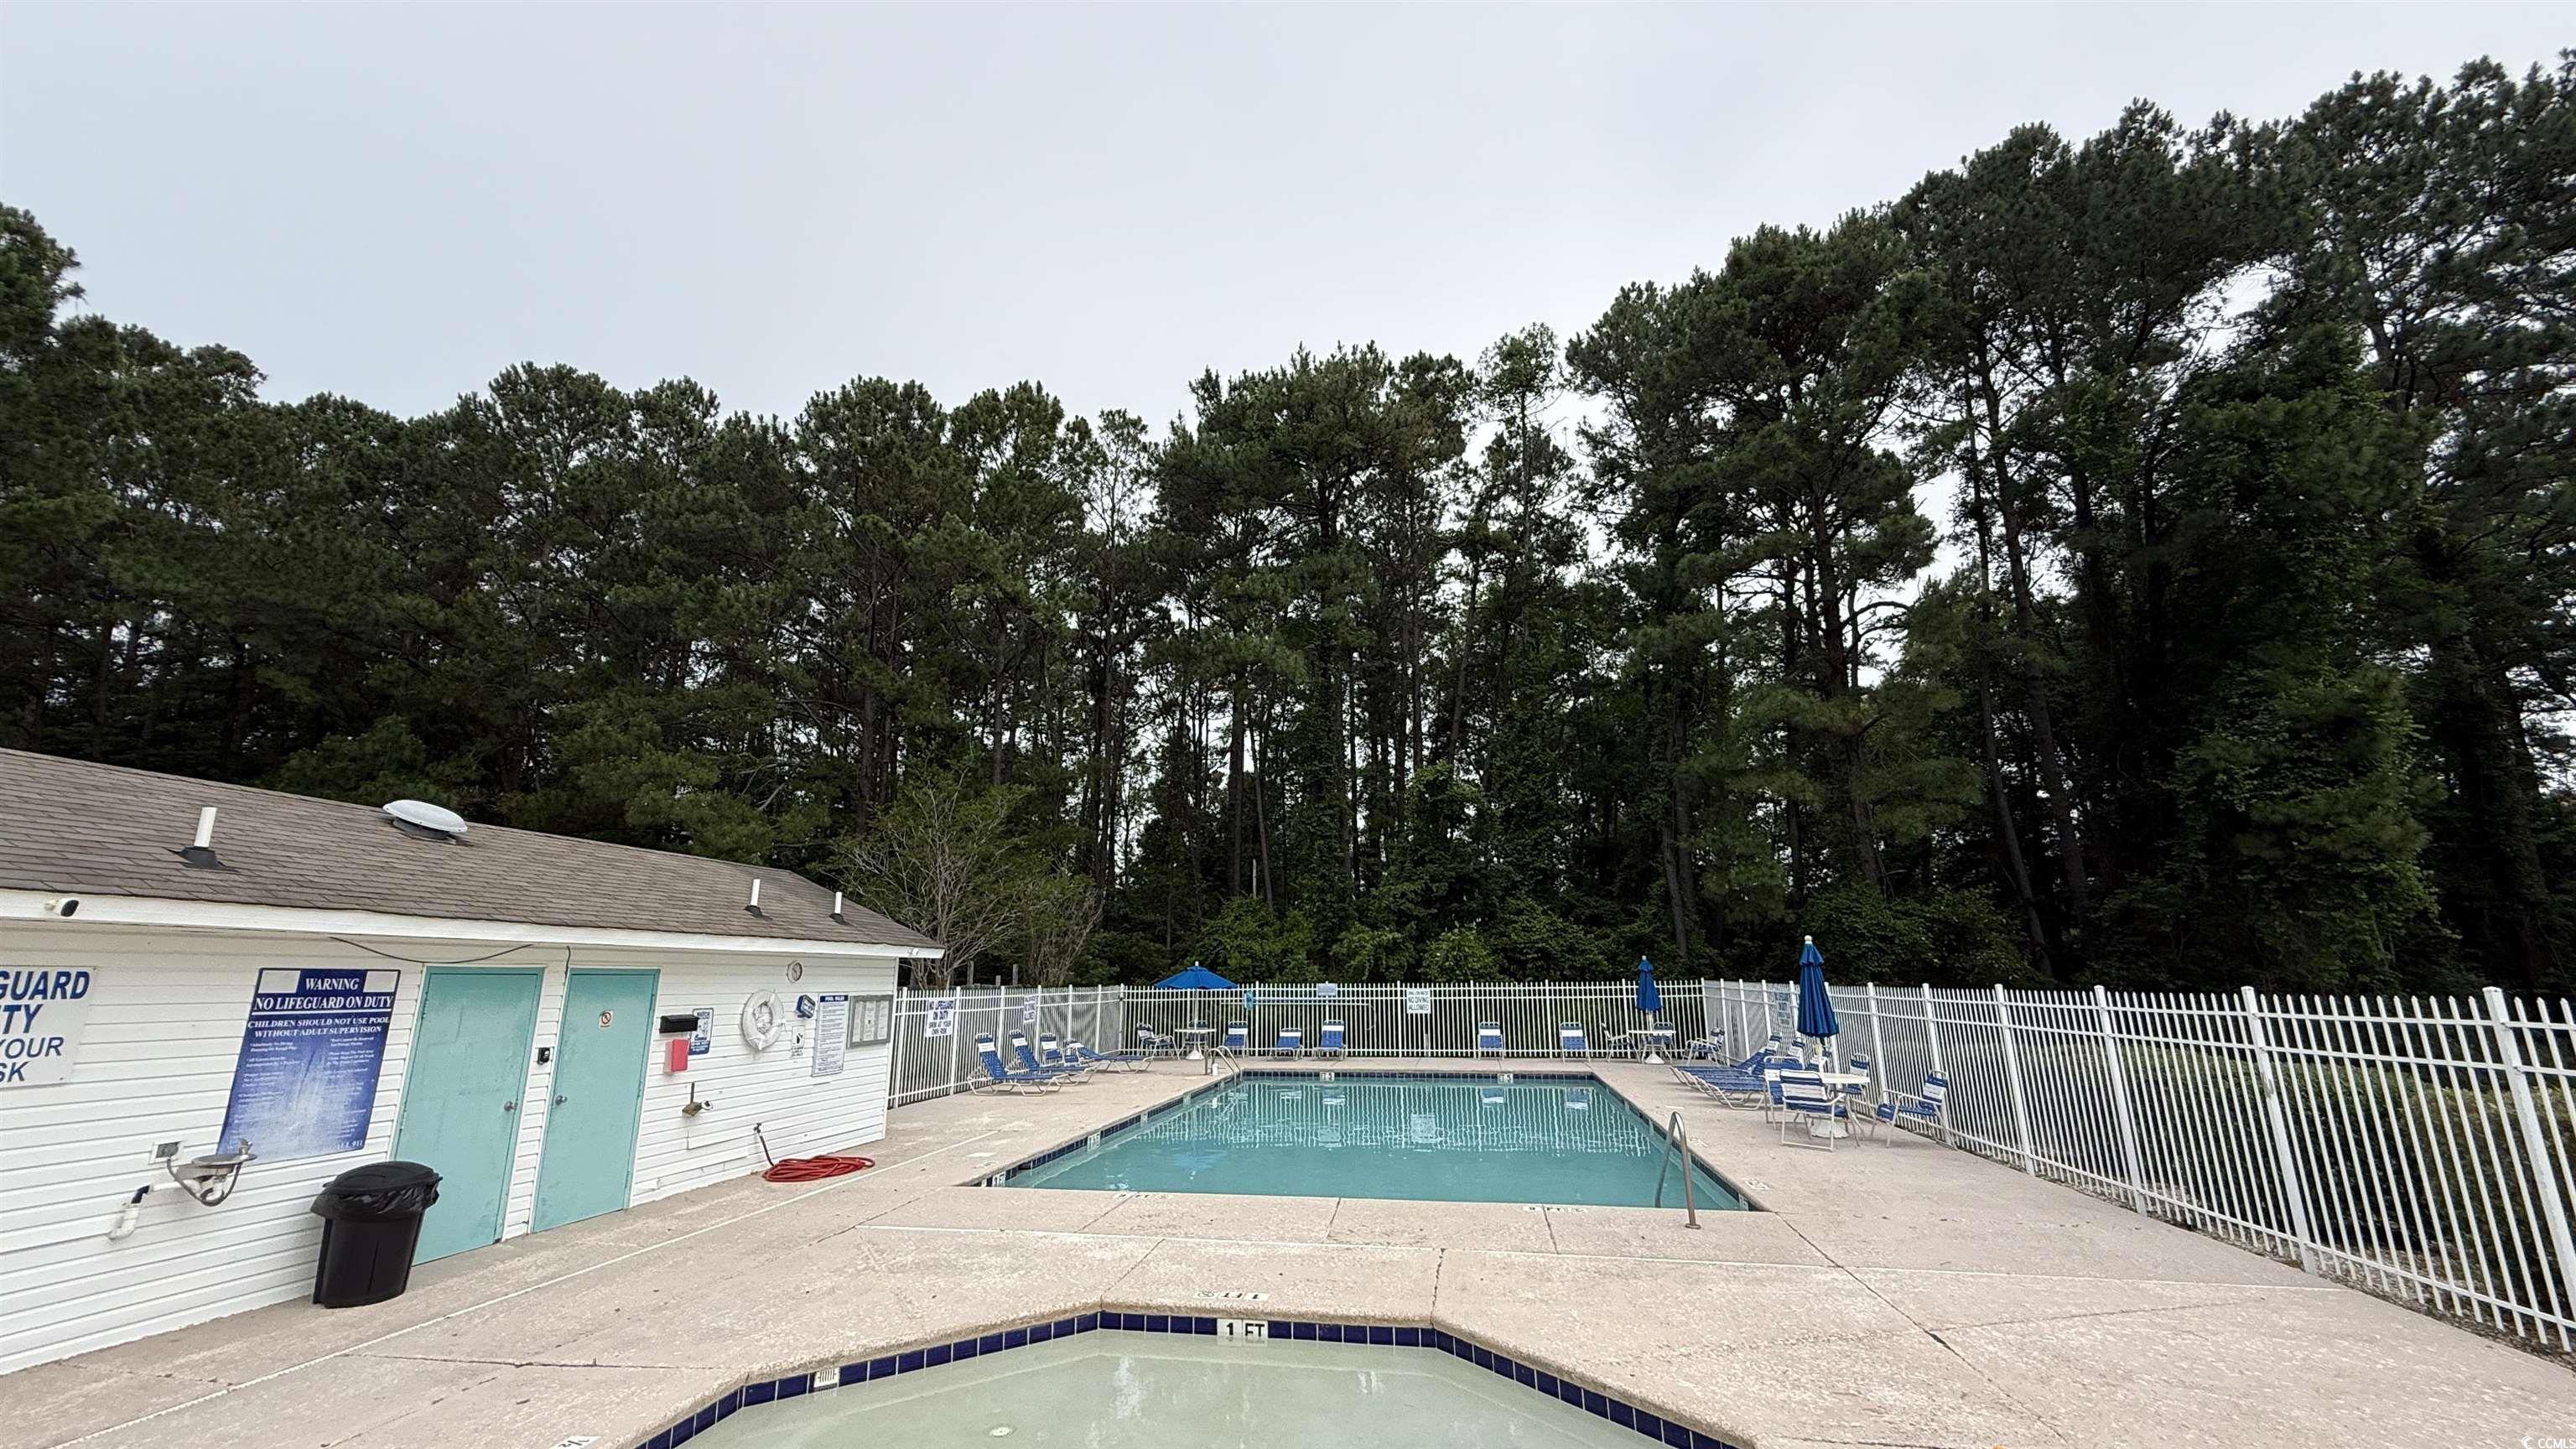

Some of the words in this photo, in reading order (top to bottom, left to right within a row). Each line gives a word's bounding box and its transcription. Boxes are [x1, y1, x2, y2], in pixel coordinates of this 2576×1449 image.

[305, 977, 359, 990] WARNING
[253, 996, 274, 1010] NO
[275, 996, 345, 1010] LIFEGUARD
[345, 995, 362, 1009] ON
[363, 995, 394, 1008] DUTY
[247, 1020, 296, 1028] CHILDREN
[297, 1018, 333, 1027] SHOULD
[255, 1030, 299, 1038] WITHOUT
[299, 1028, 329, 1036] ADULT
[330, 1026, 382, 1035] SUPERVISION
[0, 1037, 64, 1059] OUR
[1227, 1322, 1233, 1335] 1
[1245, 1322, 1265, 1337] FT
